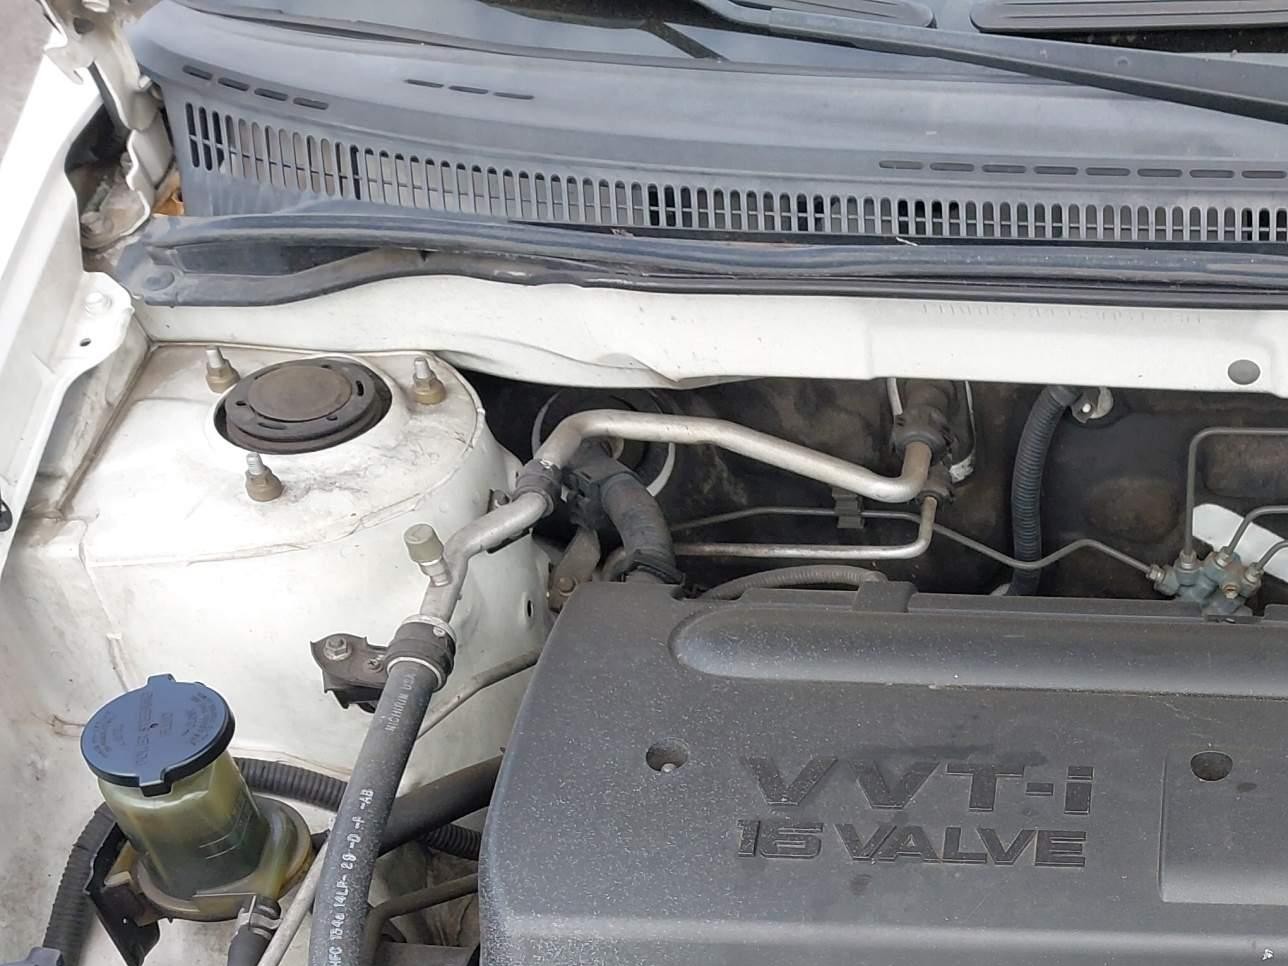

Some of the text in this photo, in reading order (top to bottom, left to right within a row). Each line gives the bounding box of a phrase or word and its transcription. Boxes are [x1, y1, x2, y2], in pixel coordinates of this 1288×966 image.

[743, 757, 1095, 815] VVT-i
[736, 819, 1087, 867] 16 VALVE
